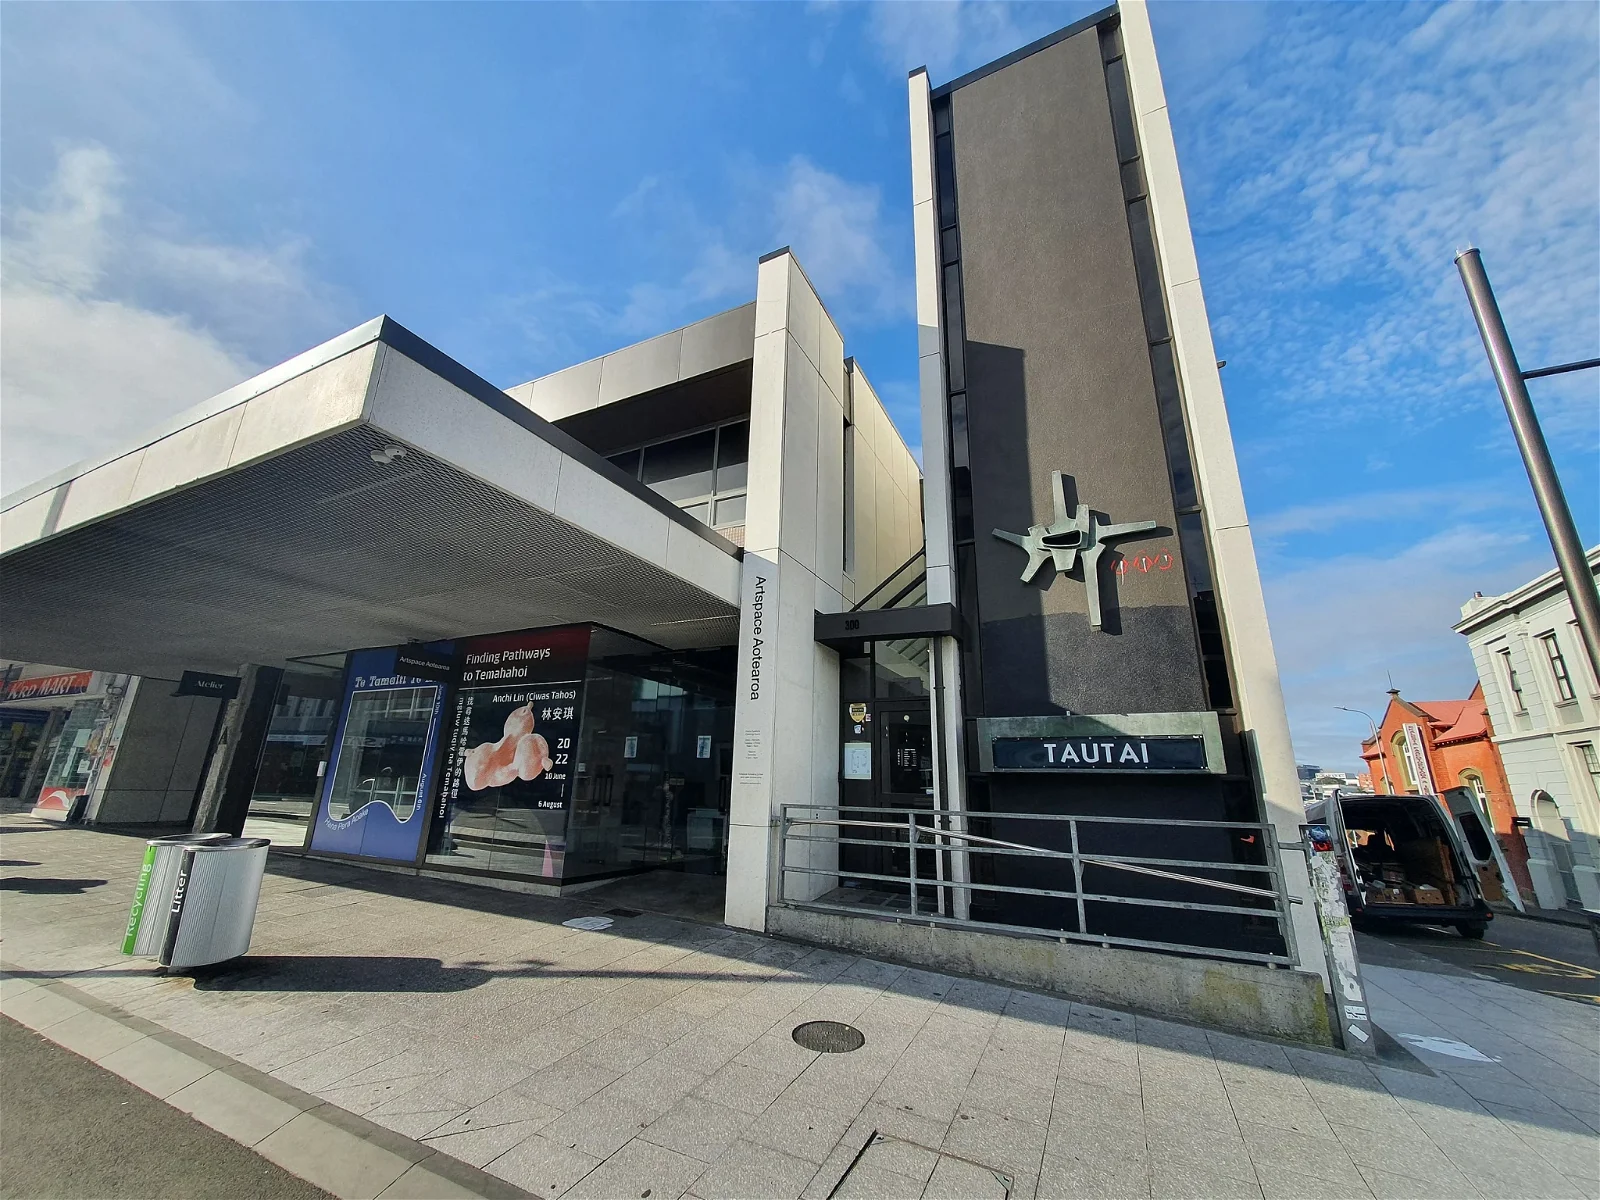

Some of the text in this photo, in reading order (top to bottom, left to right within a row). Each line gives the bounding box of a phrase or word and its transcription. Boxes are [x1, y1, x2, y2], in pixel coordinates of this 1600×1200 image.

[845, 619, 860, 631] 300
[750, 575, 767, 701] Artspace Aotearoa
[399, 656, 450, 671] Artspace Aotearoa
[465, 647, 551, 665] Finding Pathways
[463, 665, 529, 681] to Temahahoi
[354, 676, 366, 688] Te
[492, 689, 577, 703] Anchi Lin (Ciwas Tahos)
[541, 706, 575, 721] 林安琪
[556, 738, 571, 749] 20
[554, 753, 569, 765] 22
[1043, 742, 1150, 763] TAUTAI
[552, 772, 567, 780] June
[543, 801, 563, 809] August
[171, 869, 188, 913] Litter
[126, 863, 152, 937] Recycling
